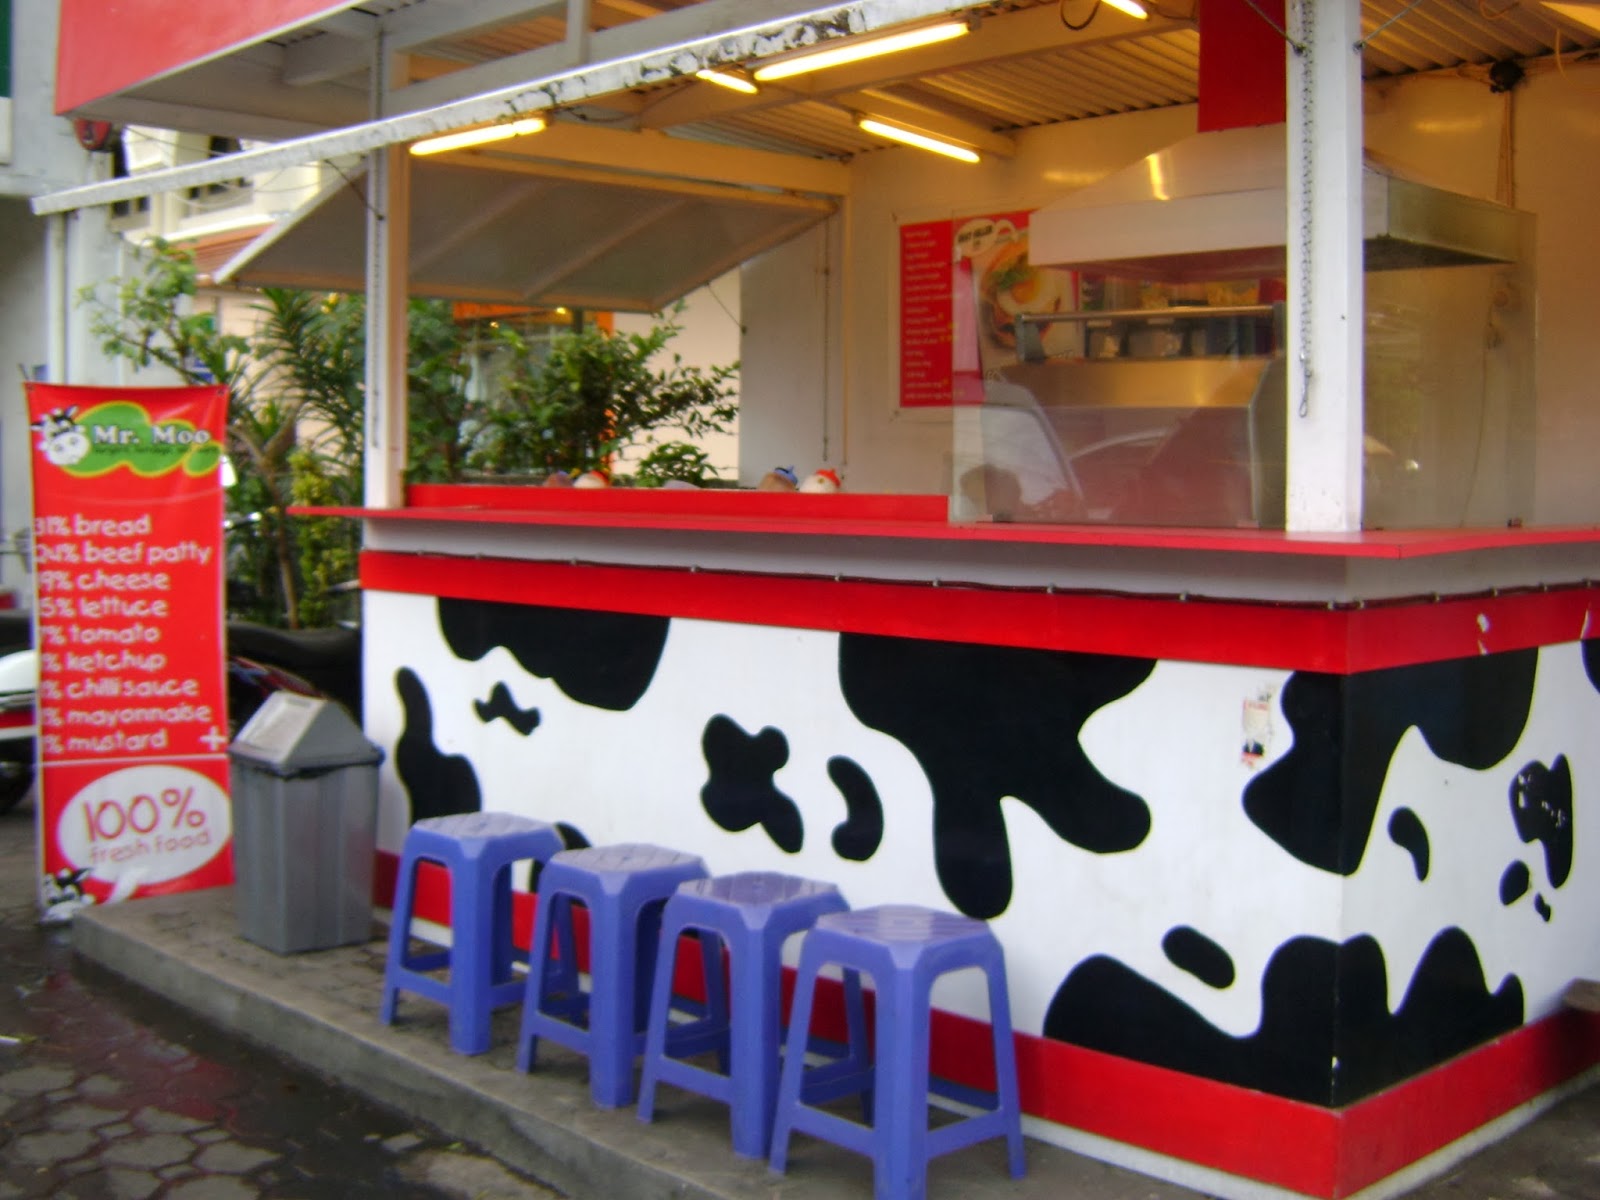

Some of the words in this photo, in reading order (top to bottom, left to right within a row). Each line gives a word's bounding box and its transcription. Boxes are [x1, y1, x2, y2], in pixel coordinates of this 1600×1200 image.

[93, 425, 140, 445] Mr.
[152, 425, 211, 445] Moo
[74, 513, 151, 536] bread
[82, 540, 144, 563] beef
[147, 540, 212, 565] patty
[76, 569, 170, 590] cheese
[79, 596, 168, 618] lettuce
[69, 622, 160, 644] tomato
[66, 649, 168, 672] ketchup
[66, 677, 120, 698] chilli
[122, 678, 199, 697] sauce
[66, 702, 212, 726] mayonnaise
[66, 728, 168, 752] mustard
[82, 785, 206, 842] 100%
[88, 838, 150, 864] fresh
[154, 830, 213, 853] food
